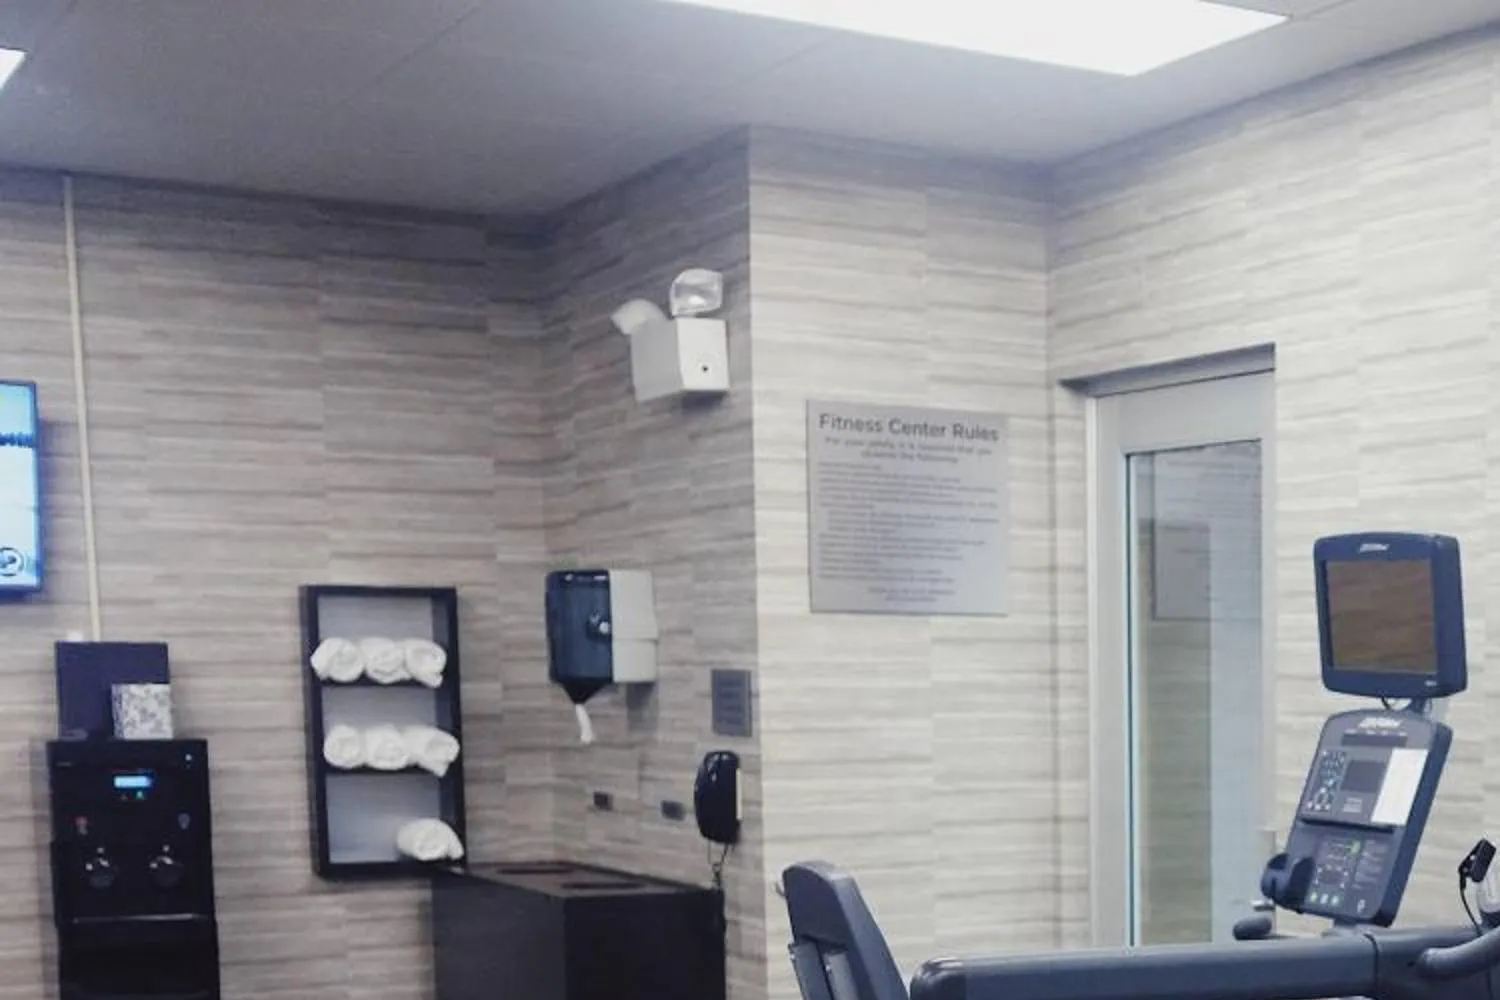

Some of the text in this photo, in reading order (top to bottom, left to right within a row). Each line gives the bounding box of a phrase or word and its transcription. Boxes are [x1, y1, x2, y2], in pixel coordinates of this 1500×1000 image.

[818, 412, 1000, 442] Fitness Center Rules
